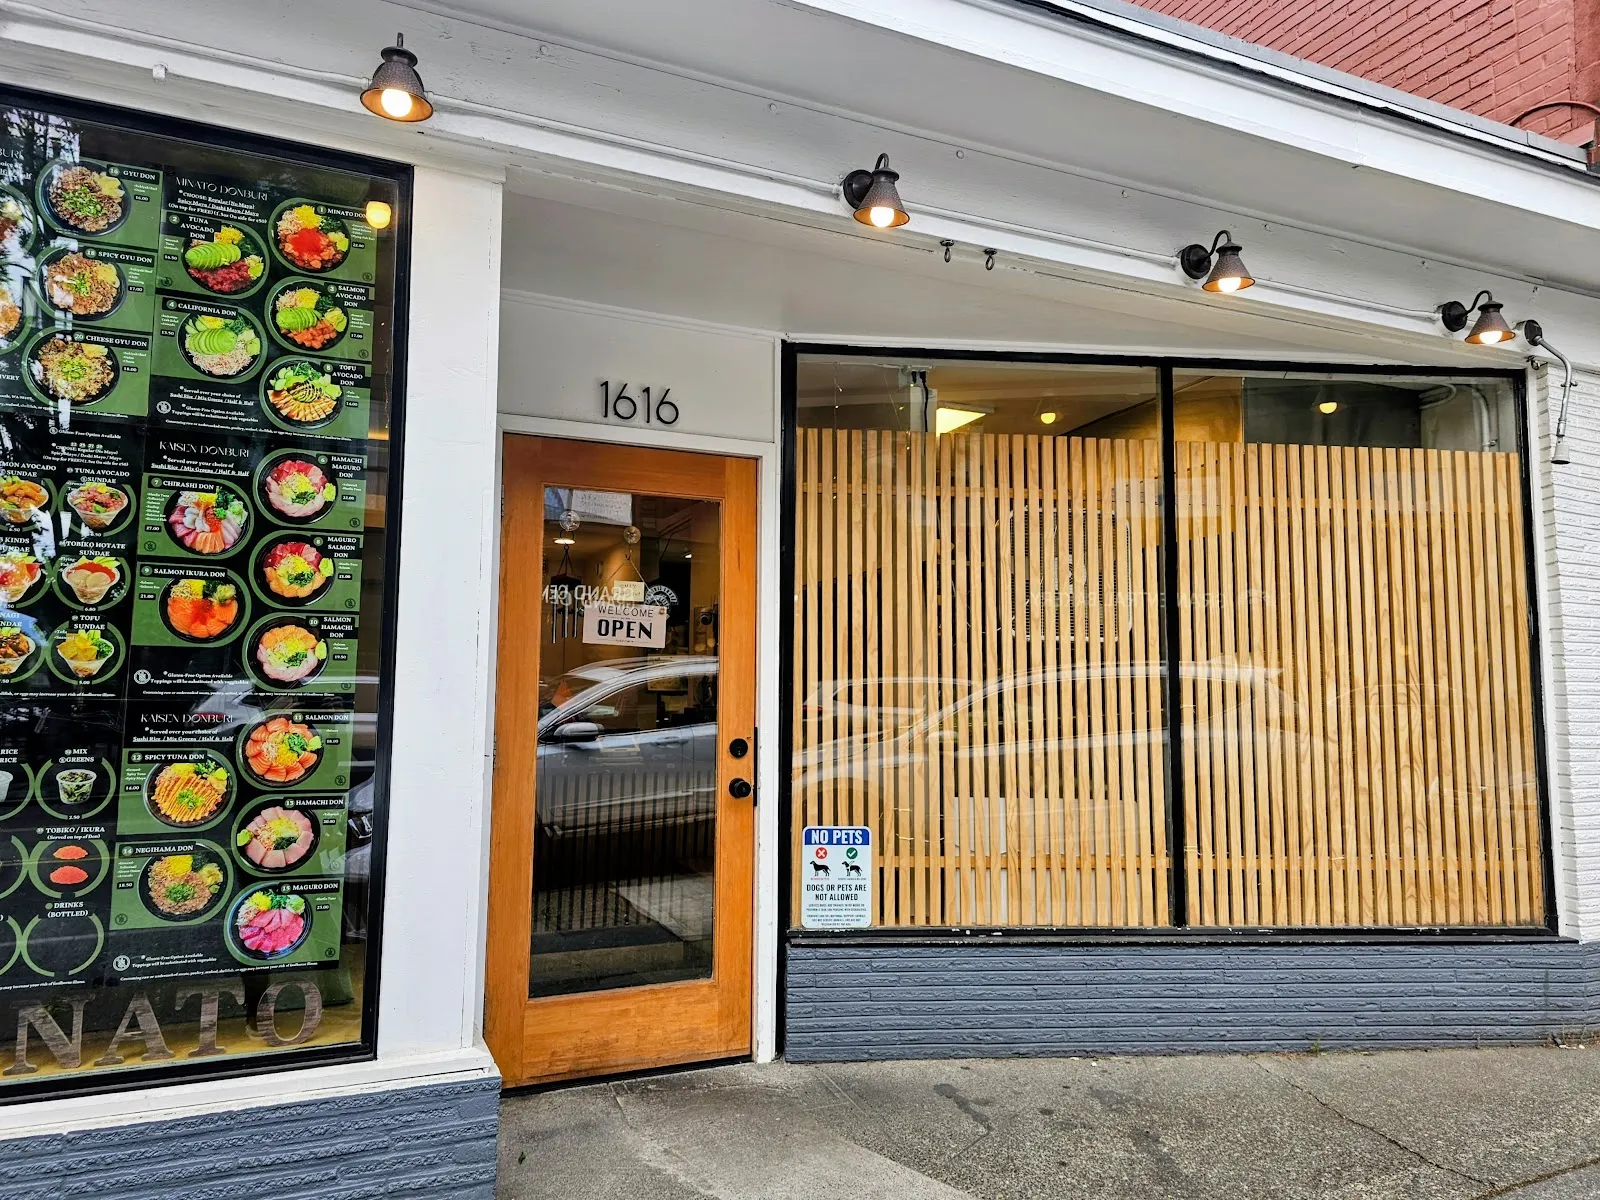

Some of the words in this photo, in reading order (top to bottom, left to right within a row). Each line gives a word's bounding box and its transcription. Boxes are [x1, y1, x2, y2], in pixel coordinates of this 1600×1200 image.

[123, 170, 139, 179] GYU
[176, 177, 217, 192] MINATO
[220, 185, 267, 201] DONBURI
[327, 208, 353, 216] MINATO
[189, 216, 208, 224] TUNA
[181, 223, 214, 233] AVOCADO
[98, 252, 119, 260] SPICY
[120, 253, 135, 261] GYU
[136, 255, 152, 263] DON
[178, 303, 220, 314] CALIFORNIA
[86, 335, 114, 344] CHEESE
[600, 380, 679, 424] 1616
[160, 441, 196, 453] KAISEN
[200, 445, 249, 458] DONBURI
[163, 480, 197, 488] CHIRASHI
[598, 605, 654, 618] WELCOME
[597, 619, 652, 639] OPEN
[140, 714, 178, 722] KAISEN
[183, 714, 233, 723] DONBURI
[811, 830, 828, 844] NO
[833, 830, 863, 844] PETS
[48, 910, 88, 918] (BOTTLED)
[2, 977, 323, 1077] NATO
